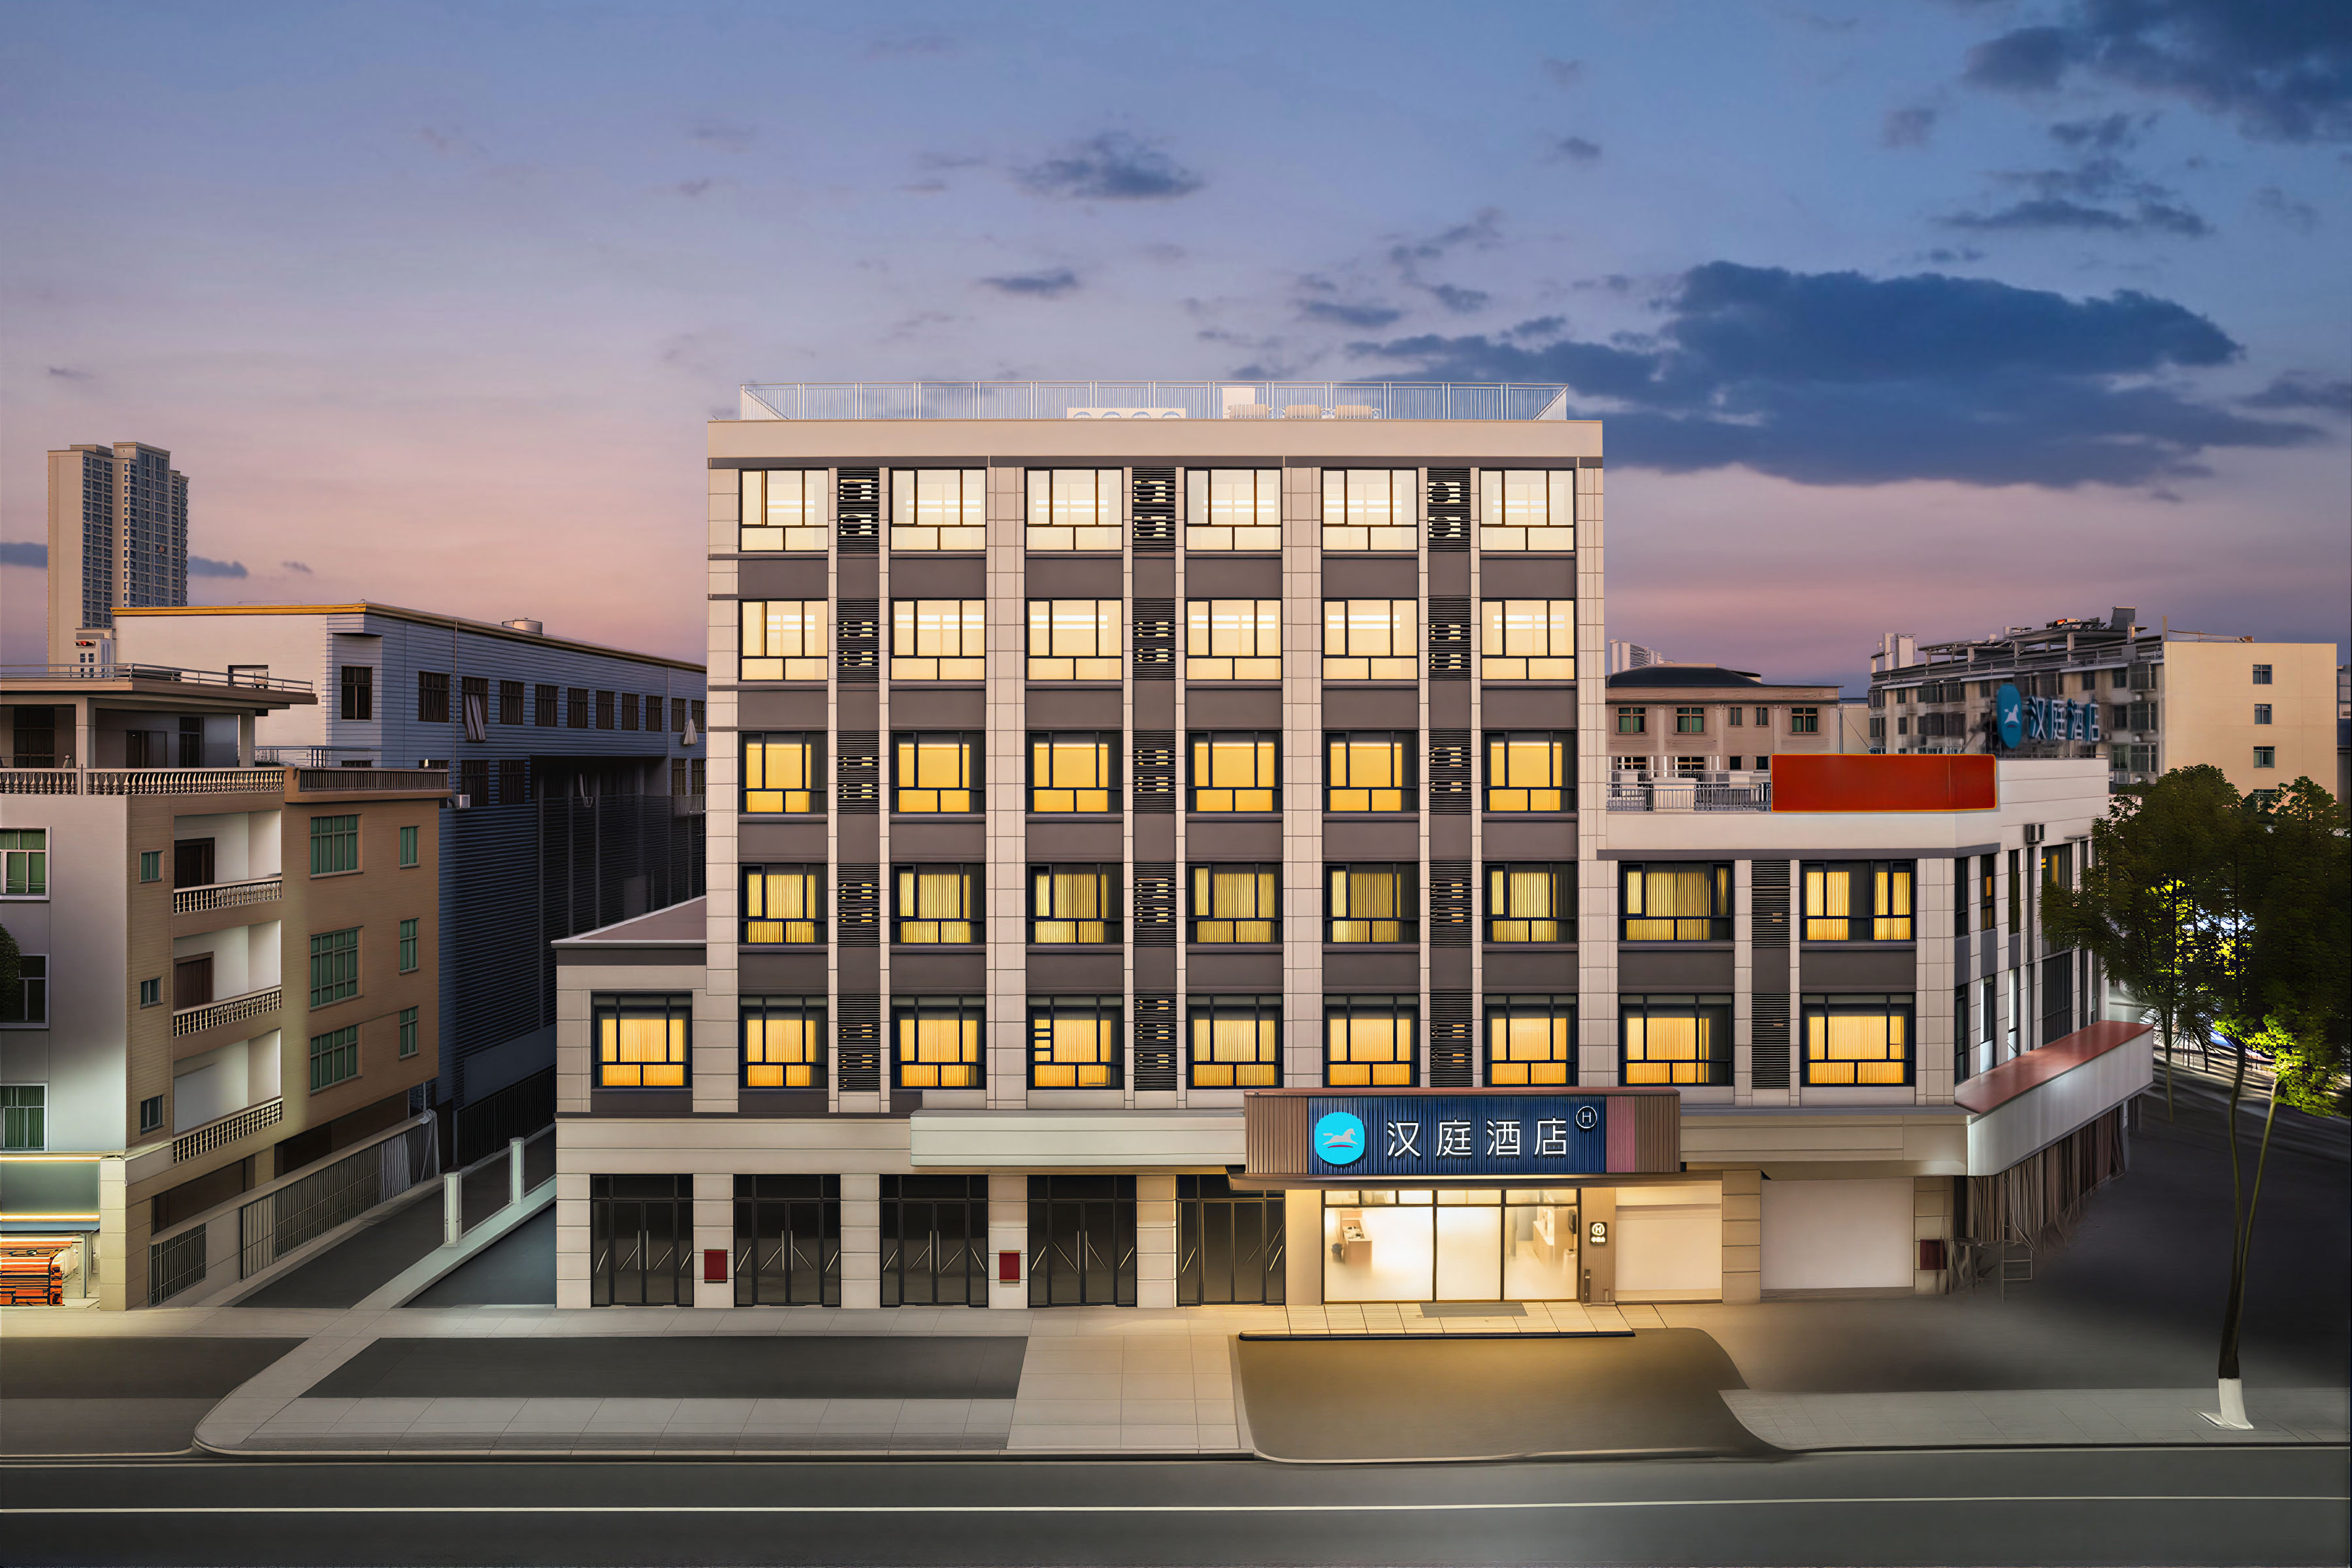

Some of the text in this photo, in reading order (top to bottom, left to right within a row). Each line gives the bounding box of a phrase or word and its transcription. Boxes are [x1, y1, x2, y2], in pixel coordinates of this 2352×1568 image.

[2029, 696, 2099, 742] 汉庭酒店
[1386, 1117, 1567, 1157] 汉庭酒店
[1582, 1111, 1592, 1123] H
